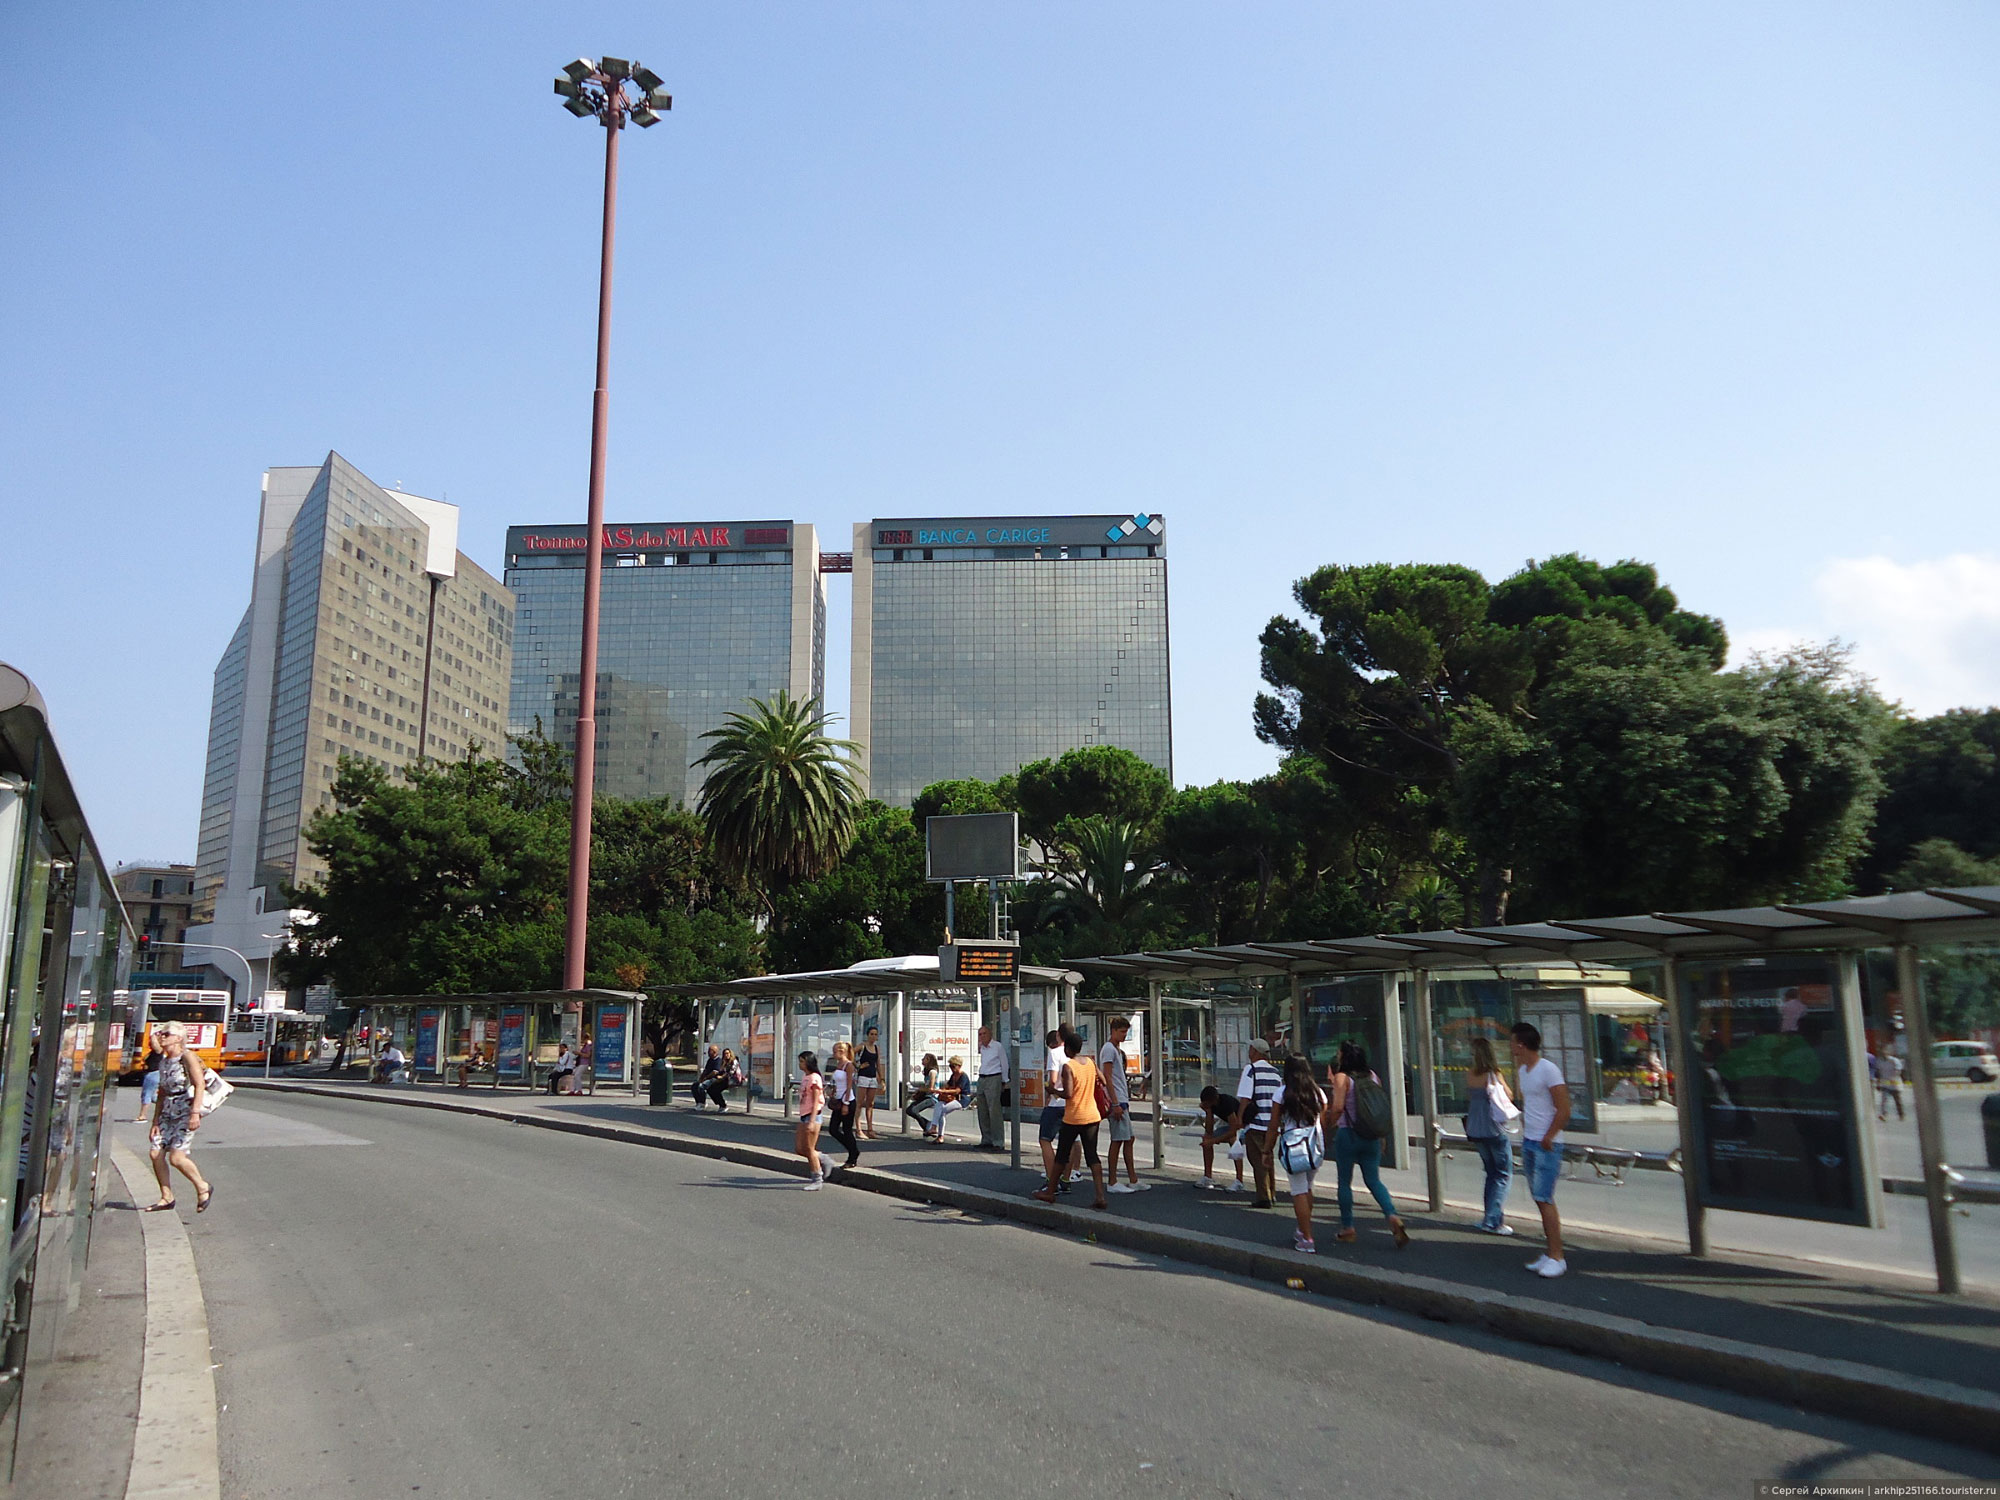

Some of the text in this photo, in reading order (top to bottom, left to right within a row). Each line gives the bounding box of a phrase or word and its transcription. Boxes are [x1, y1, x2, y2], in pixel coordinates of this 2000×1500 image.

[522, 534, 588, 549] Tonno
[919, 527, 1050, 545] BANCA CARIGE
[945, 1037, 969, 1045] PENNA
